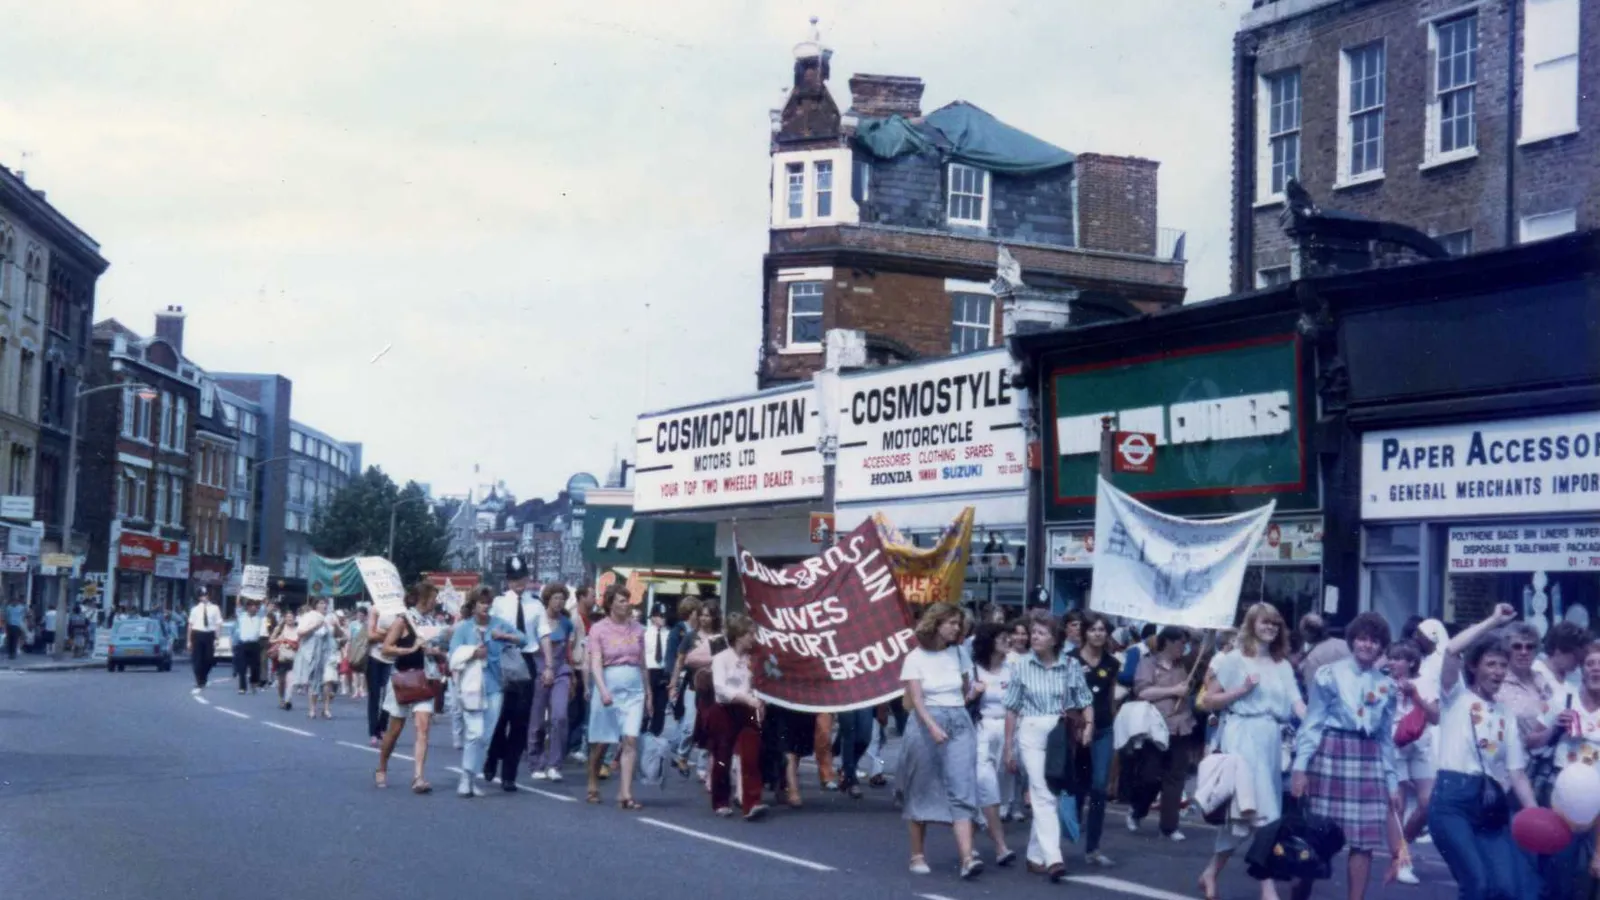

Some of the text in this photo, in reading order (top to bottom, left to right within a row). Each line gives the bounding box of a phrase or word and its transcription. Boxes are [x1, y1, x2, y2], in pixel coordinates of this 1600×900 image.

[852, 369, 1012, 425] COSMOSTYLE
[656, 398, 806, 453] COSMOPOLITAN
[883, 421, 973, 450] MOTORCYCLE
[694, 451, 732, 472] MOTORS
[862, 443, 994, 470] ACCESSORIES CLOTHING SPARES
[1381, 438, 1455, 471] PAPER
[660, 482, 679, 498] YOUR
[683, 480, 697, 496] TOP
[702, 478, 718, 494] TWO
[723, 474, 758, 492] WHEELER
[763, 470, 794, 489] DEALER
[870, 470, 913, 486] HONDA
[942, 463, 983, 480] SUZUKI
[1389, 482, 1447, 502] GENERAL
[1456, 477, 1542, 498] MERCHANTS
[596, 517, 636, 549] H
[1452, 530, 1494, 541] POLYTHENE
[1497, 529, 1519, 540] BAGS
[1541, 527, 1569, 539] LINERS
[1463, 544, 1510, 555] DISPOSABLE
[1514, 543, 1560, 554] TABLEWARE
[1452, 558, 1474, 568] TELEX
